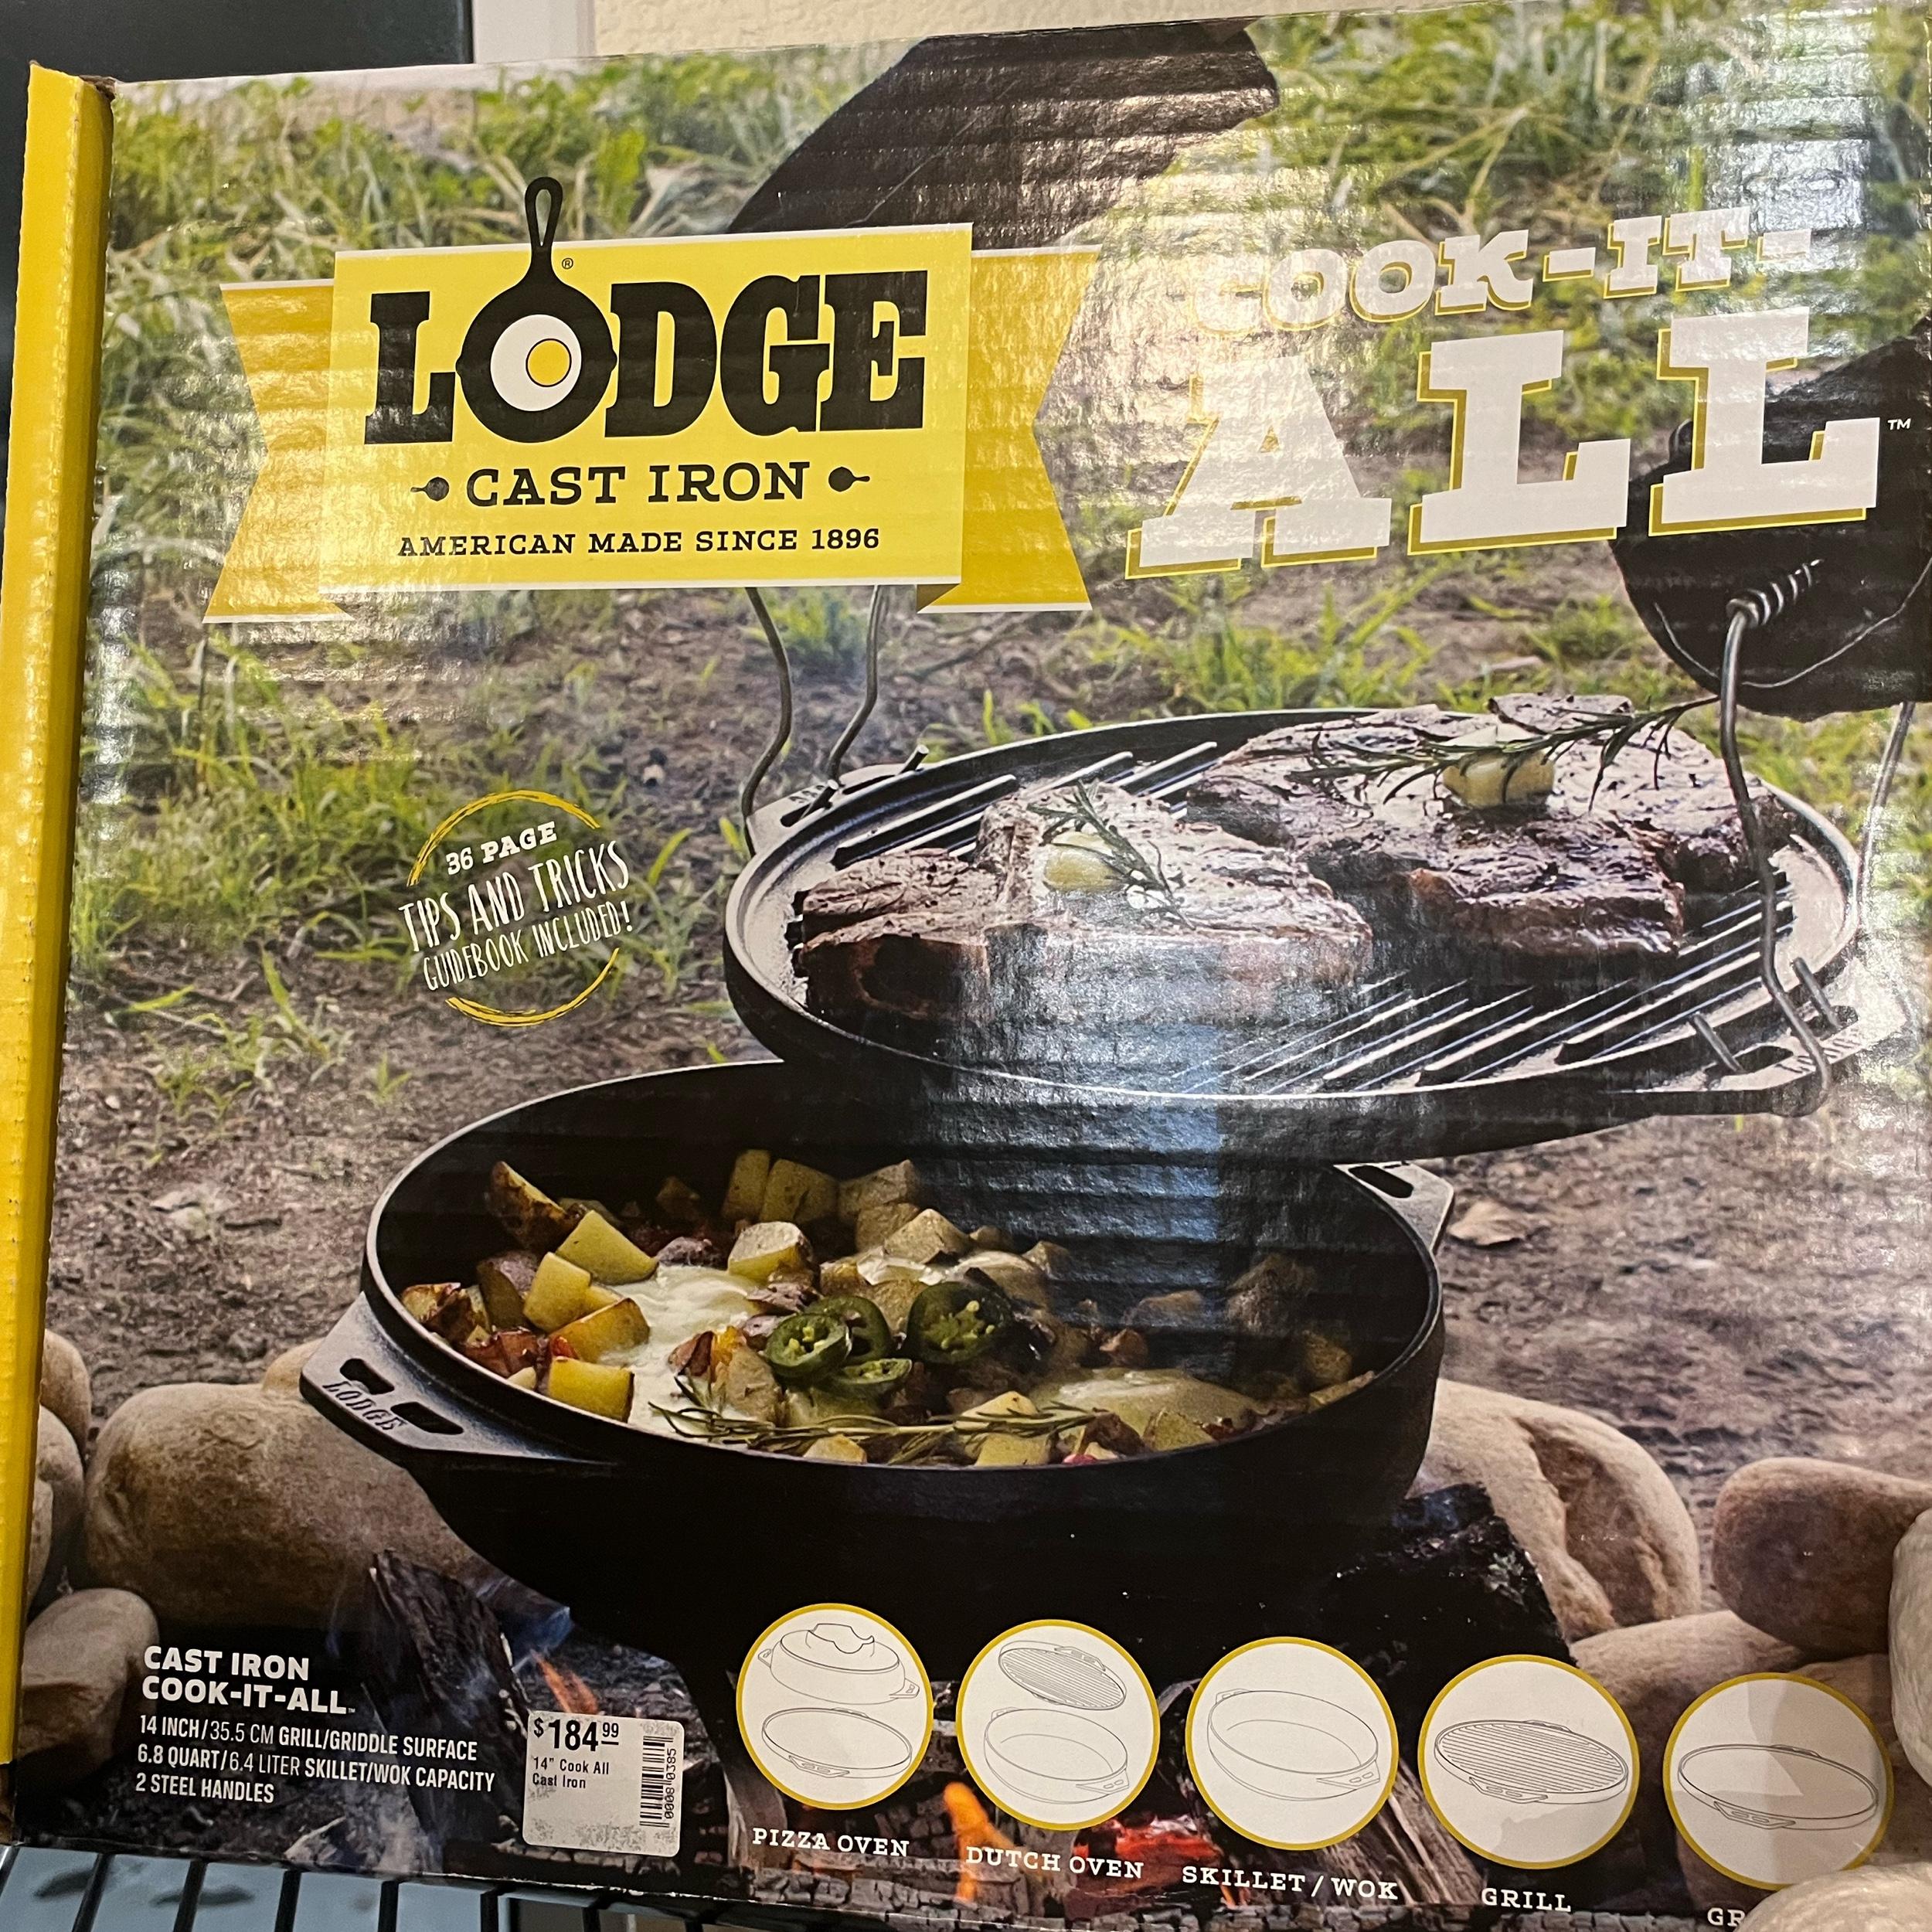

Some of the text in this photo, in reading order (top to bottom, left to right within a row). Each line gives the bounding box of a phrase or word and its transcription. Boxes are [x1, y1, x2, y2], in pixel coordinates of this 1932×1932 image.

[363, 267, 927, 444] LODGE
[1125, 306, 1880, 579] ALL
[466, 461, 810, 507] CAST IRON
[397, 528, 879, 556] AMERICAN MADE SINCE 1896
[446, 821, 557, 875] 36 PAGE
[398, 840, 629, 952] TIPS AND TRICKS
[423, 900, 634, 991] GUIDEBOOK INCLUDED!
[322, 1380, 407, 1430] LODGE
[144, 1645, 309, 1681] CAST IRON
[142, 1675, 347, 1714] COOK-IT-ALL
[140, 1714, 157, 1734] 14
[250, 1723, 274, 1744] CM
[279, 1726, 399, 1754] GRILL/GRIDDLE
[403, 1736, 478, 1761] SURFACE
[138, 1743, 164, 1764] 6.8
[259, 1753, 301, 1776] LITER
[304, 1757, 411, 1785] SKILLET/WOK
[416, 1767, 495, 1792] CAPACITY
[532, 1772, 587, 1789] Cast Iron
[560, 1758, 589, 1774] Cook
[593, 1761, 610, 1775] All
[135, 1772, 274, 1804] 2 STEEL HANDLES
[752, 1827, 910, 1858] PIZZA OVEN
[966, 1846, 1145, 1879] DUTCH OVEN
[1182, 1866, 1306, 1892] SKILLET
[1333, 1877, 1400, 1900] WOK
[1481, 1887, 1572, 1912] GRILL
